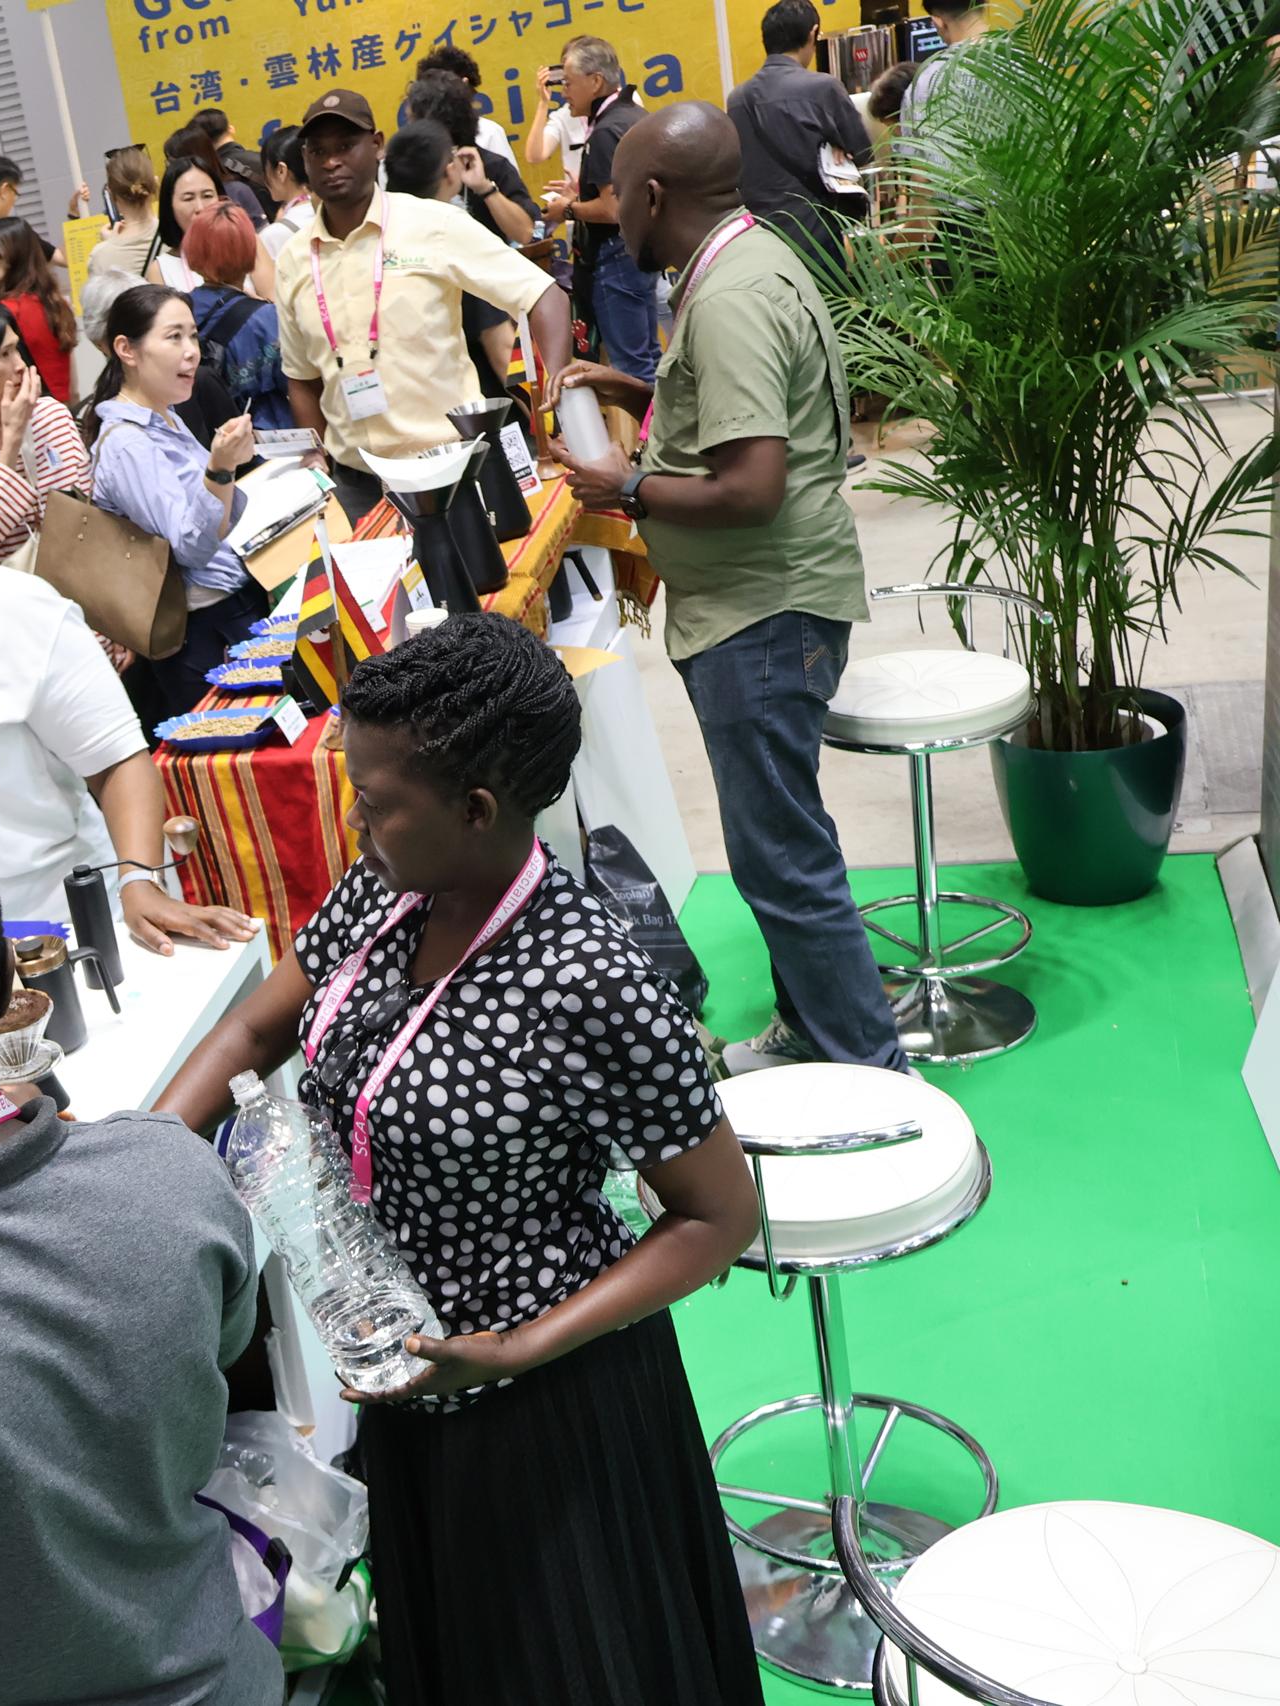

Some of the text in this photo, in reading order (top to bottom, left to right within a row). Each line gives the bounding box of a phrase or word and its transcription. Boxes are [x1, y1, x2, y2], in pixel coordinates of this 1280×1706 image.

[138, 15, 230, 53] from
[502, 855, 542, 914] Specialty
[311, 979, 346, 1040] Specialty
[354, 1108, 368, 1157] SCAJ
[367, 1034, 408, 1093] Specialty
